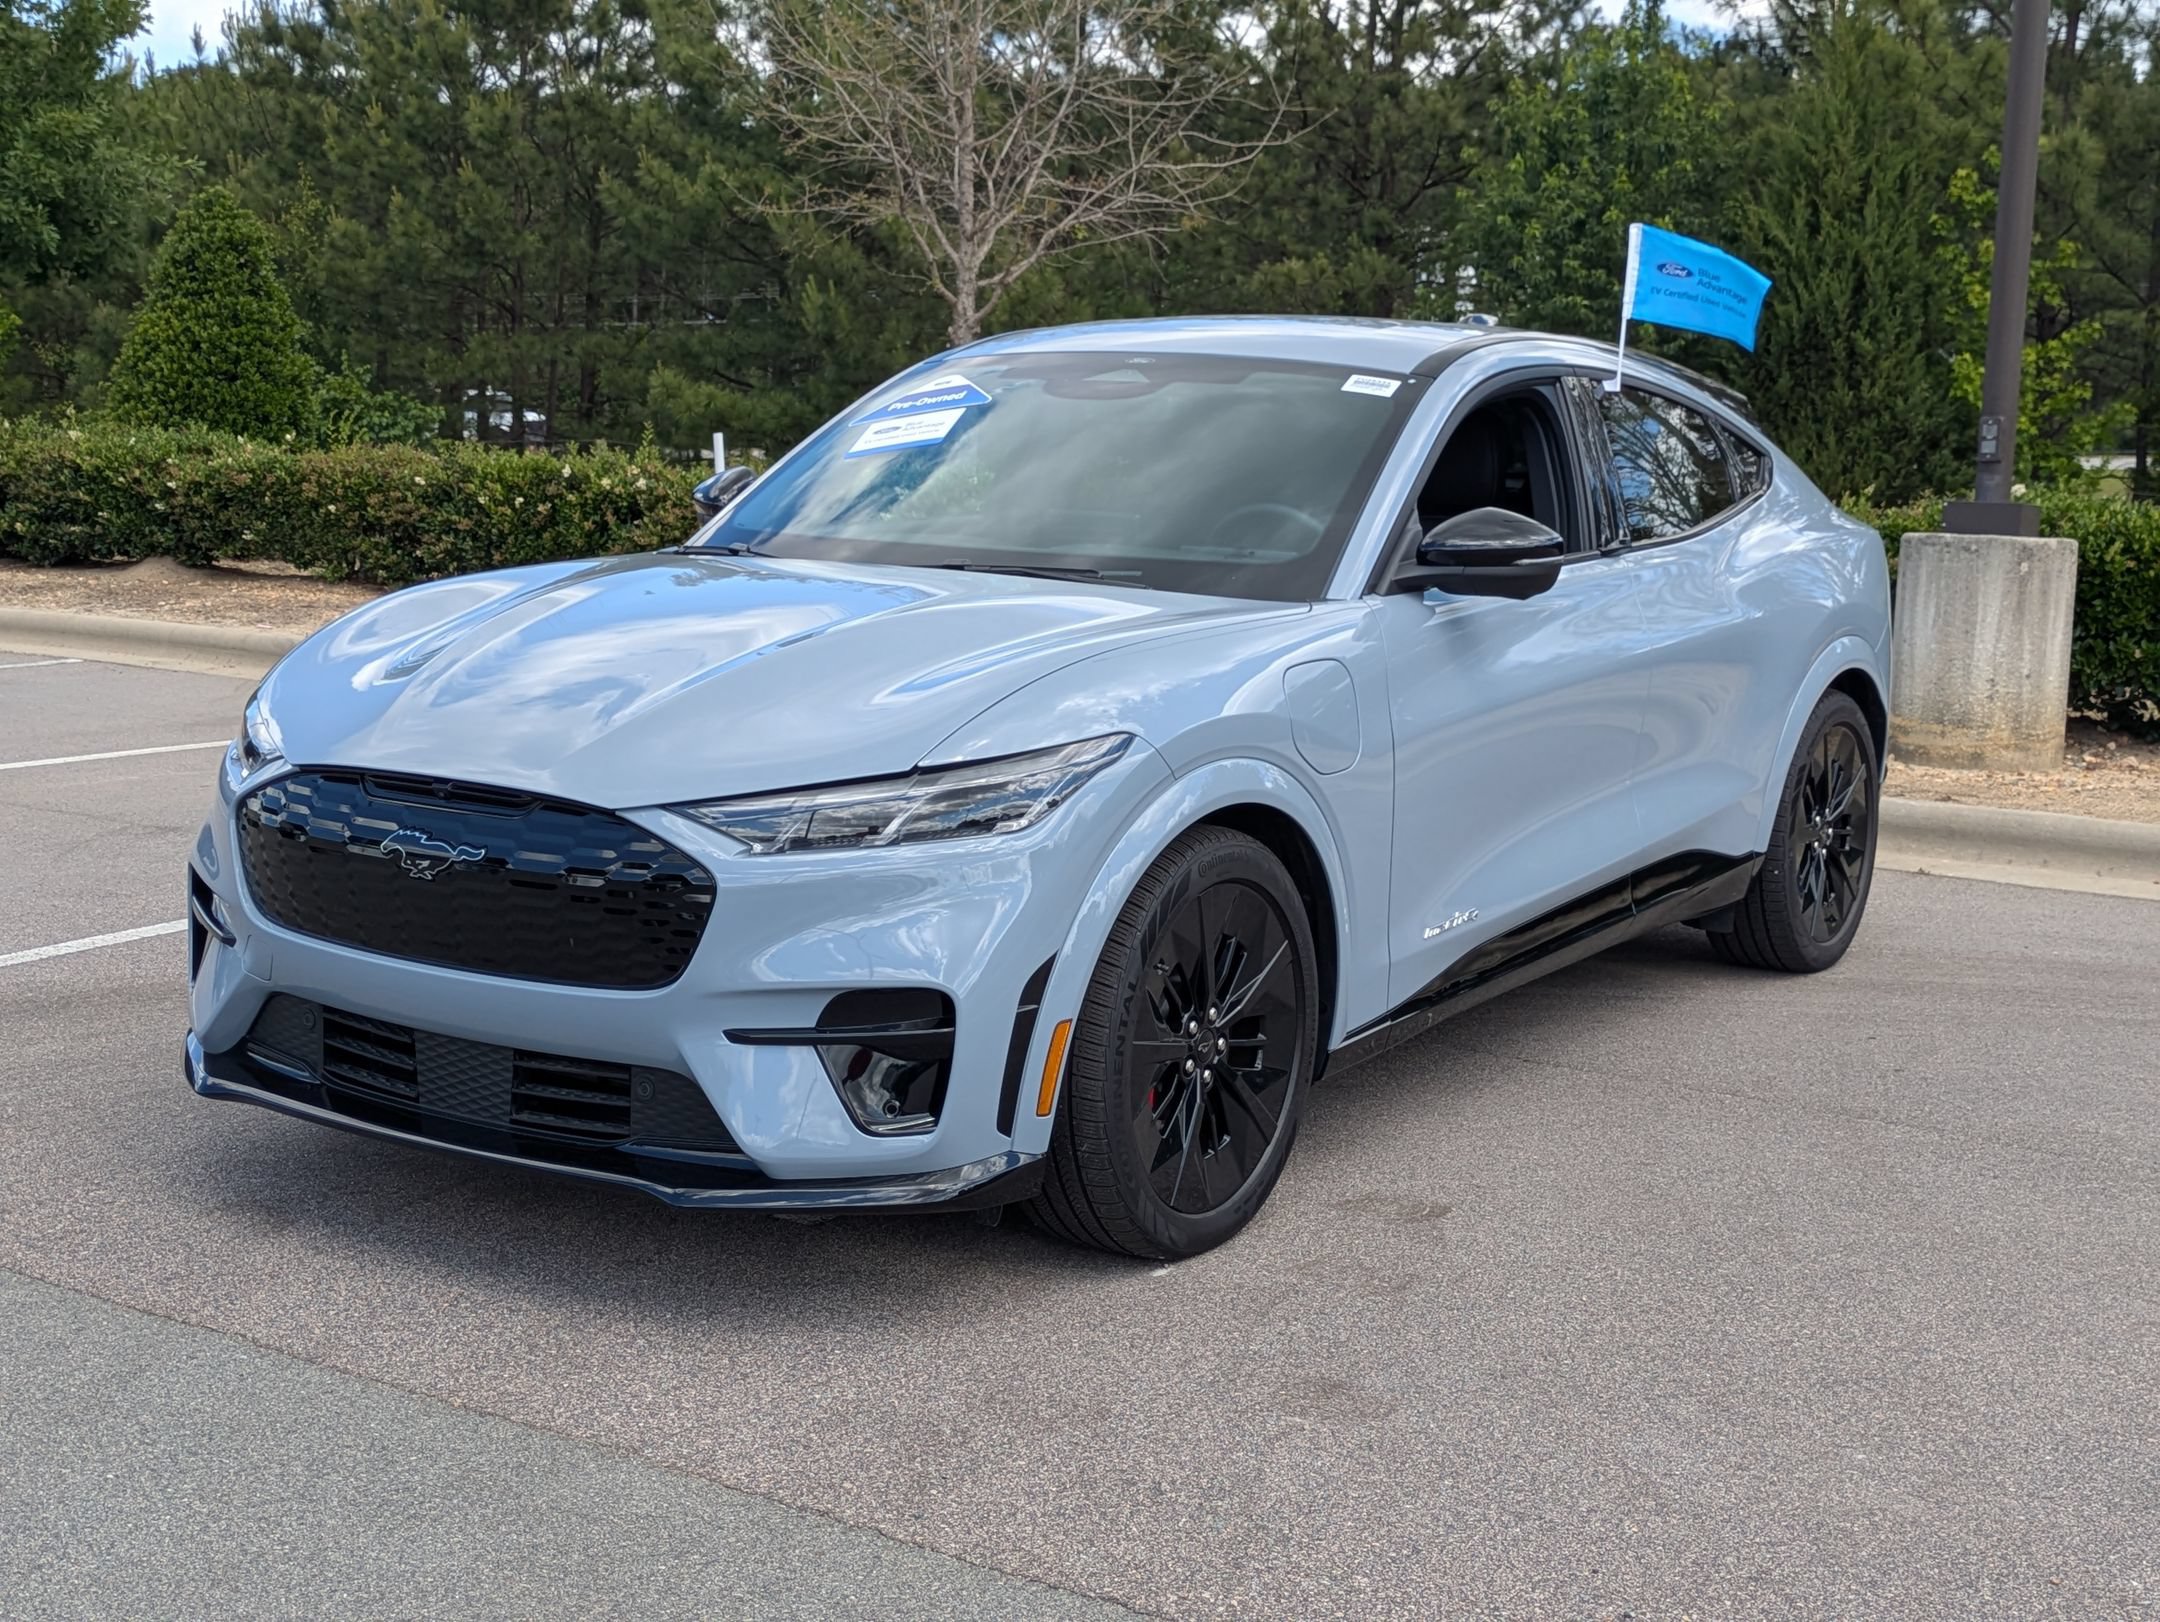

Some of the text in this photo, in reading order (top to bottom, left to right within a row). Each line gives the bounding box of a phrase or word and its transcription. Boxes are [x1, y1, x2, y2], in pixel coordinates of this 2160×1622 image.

[1661, 263, 1689, 277] Ford
[1698, 268, 1721, 281] Blue
[1650, 286, 1663, 295] EV
[1697, 279, 1747, 304] Advantage
[888, 390, 968, 412] Pre-Owned
